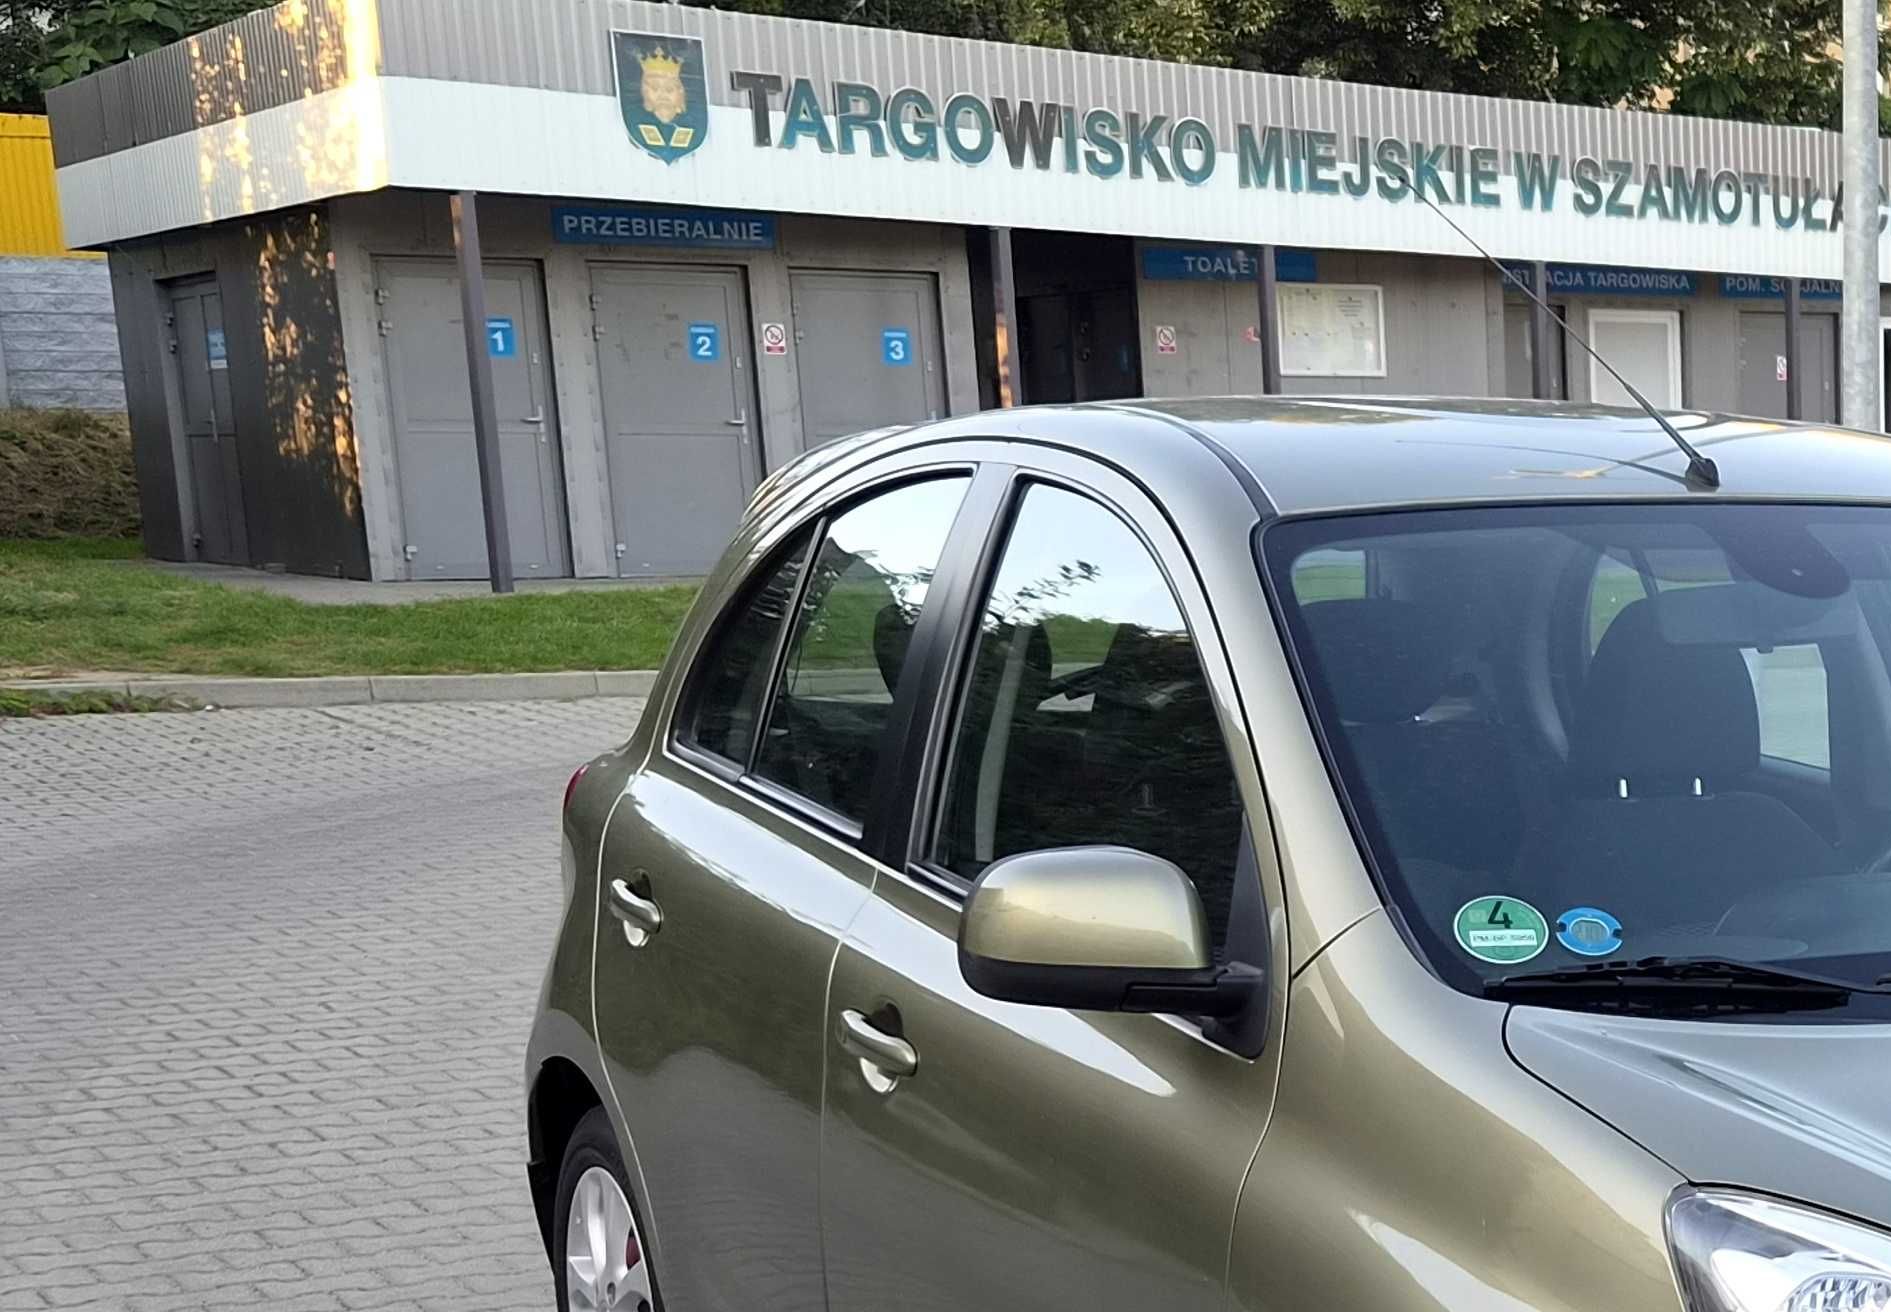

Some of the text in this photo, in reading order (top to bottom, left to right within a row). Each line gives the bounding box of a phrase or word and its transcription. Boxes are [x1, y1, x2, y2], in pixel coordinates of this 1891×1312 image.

[730, 70, 1217, 186] TARGOWISKO
[1236, 122, 1501, 208] MIEJSKIE
[1512, 150, 1561, 212] W
[562, 213, 764, 241] PRZEBIERALNIE
[1586, 271, 1691, 290] TARGOWISKA
[1725, 276, 1766, 292] POM.
[491, 330, 504, 352] 1
[696, 335, 713, 356] 2
[889, 340, 905, 360] 3
[1487, 900, 1514, 929] 4
